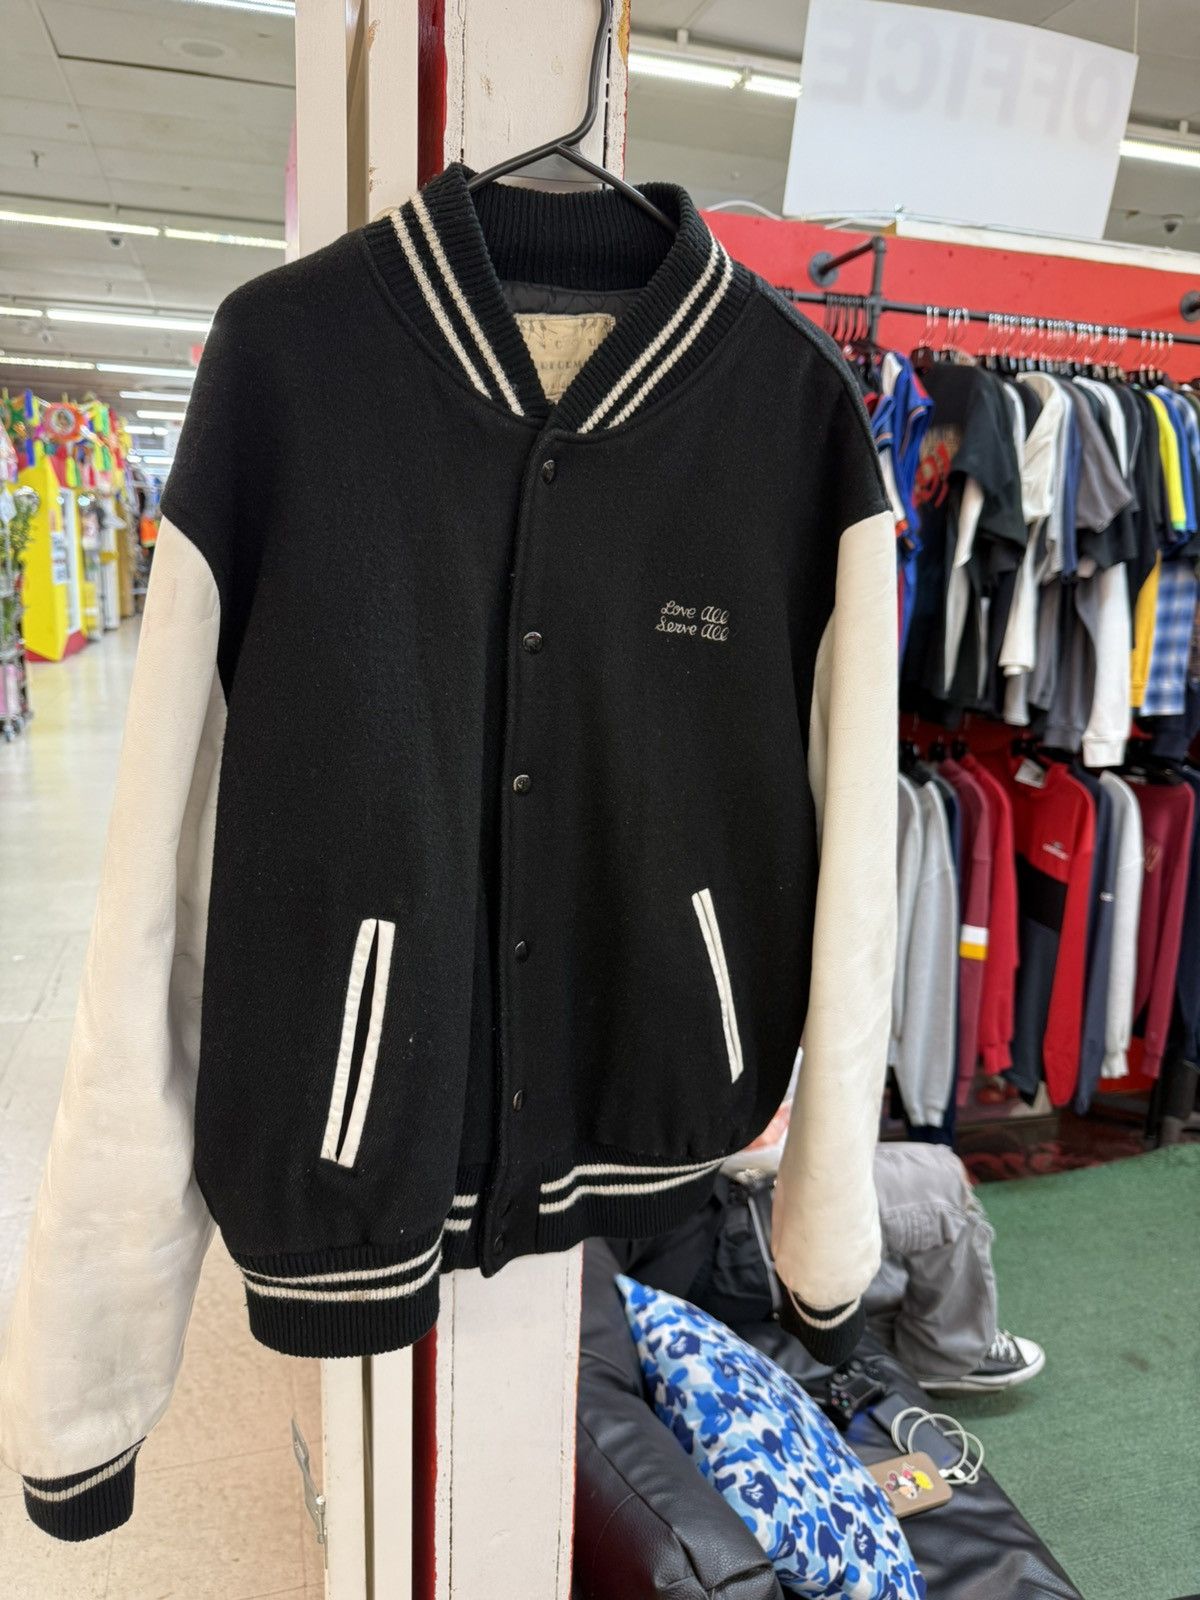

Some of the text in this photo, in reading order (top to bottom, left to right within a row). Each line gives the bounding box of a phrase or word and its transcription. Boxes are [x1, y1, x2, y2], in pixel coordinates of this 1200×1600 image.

[660, 600, 730, 625] Love All
[655, 615, 729, 641] Serve All
